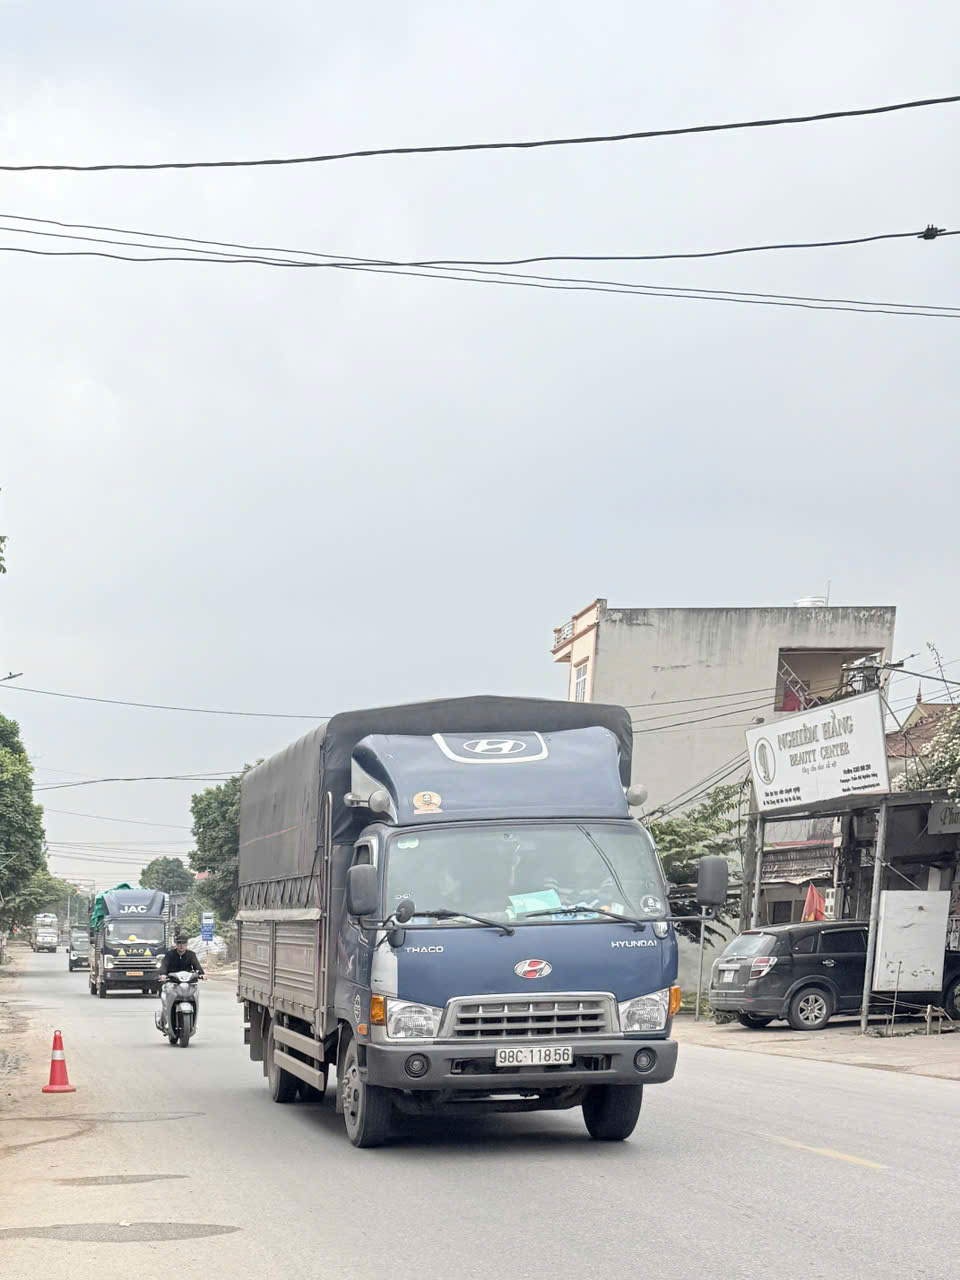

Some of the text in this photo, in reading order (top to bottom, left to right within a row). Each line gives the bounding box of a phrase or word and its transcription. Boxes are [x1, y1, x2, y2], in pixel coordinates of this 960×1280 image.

[789, 749, 817, 767] BEAUTY
[820, 741, 850, 760] CENTER
[119, 905, 148, 913] JAC
[611, 940, 657, 948] HYUNDAI
[498, 1048, 570, 1064] 98C-118.56
